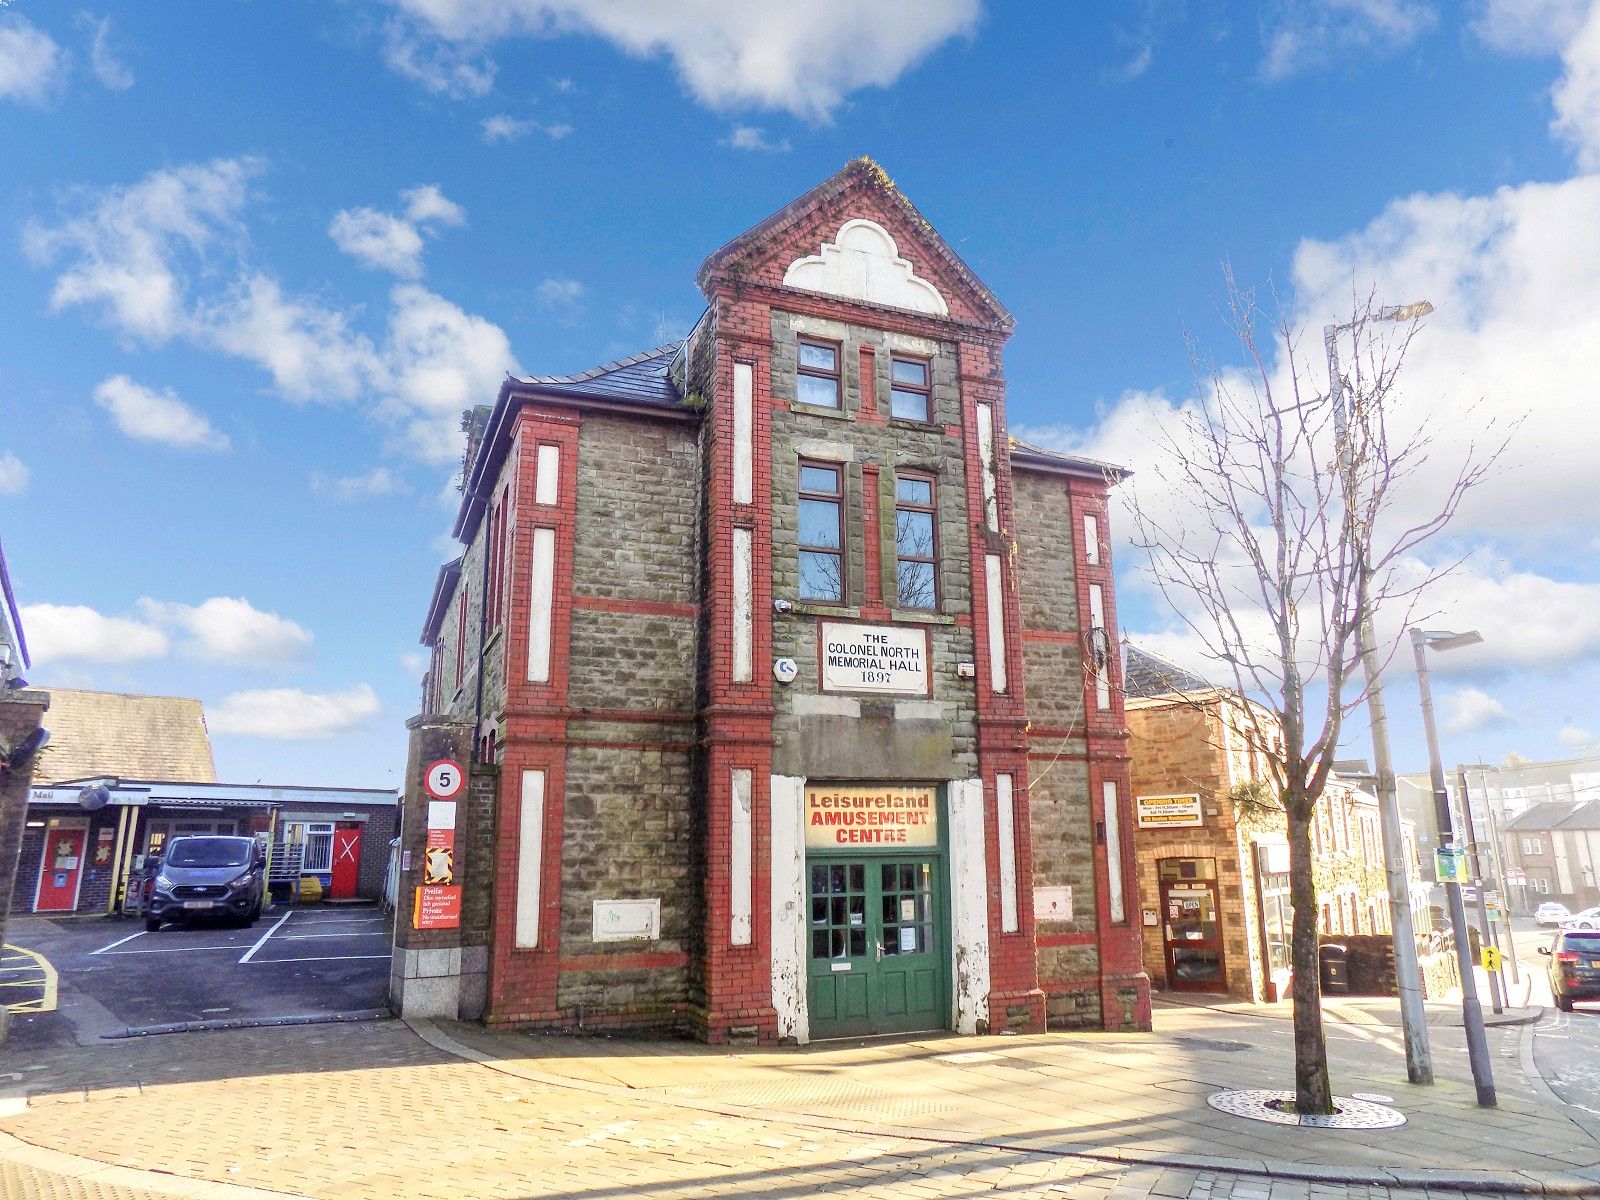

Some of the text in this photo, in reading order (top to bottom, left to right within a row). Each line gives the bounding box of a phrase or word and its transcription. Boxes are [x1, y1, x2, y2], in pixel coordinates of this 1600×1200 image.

[863, 634, 888, 644] THE
[828, 643, 919, 659] COLONEL NORTH
[828, 656, 922, 673] MEMORIAL HALL
[860, 671, 892, 684] 1897
[439, 772, 451, 788] 5
[810, 793, 929, 808] Leisureland
[811, 811, 929, 826] AMUSEMENT
[835, 828, 907, 843] CENTRE
